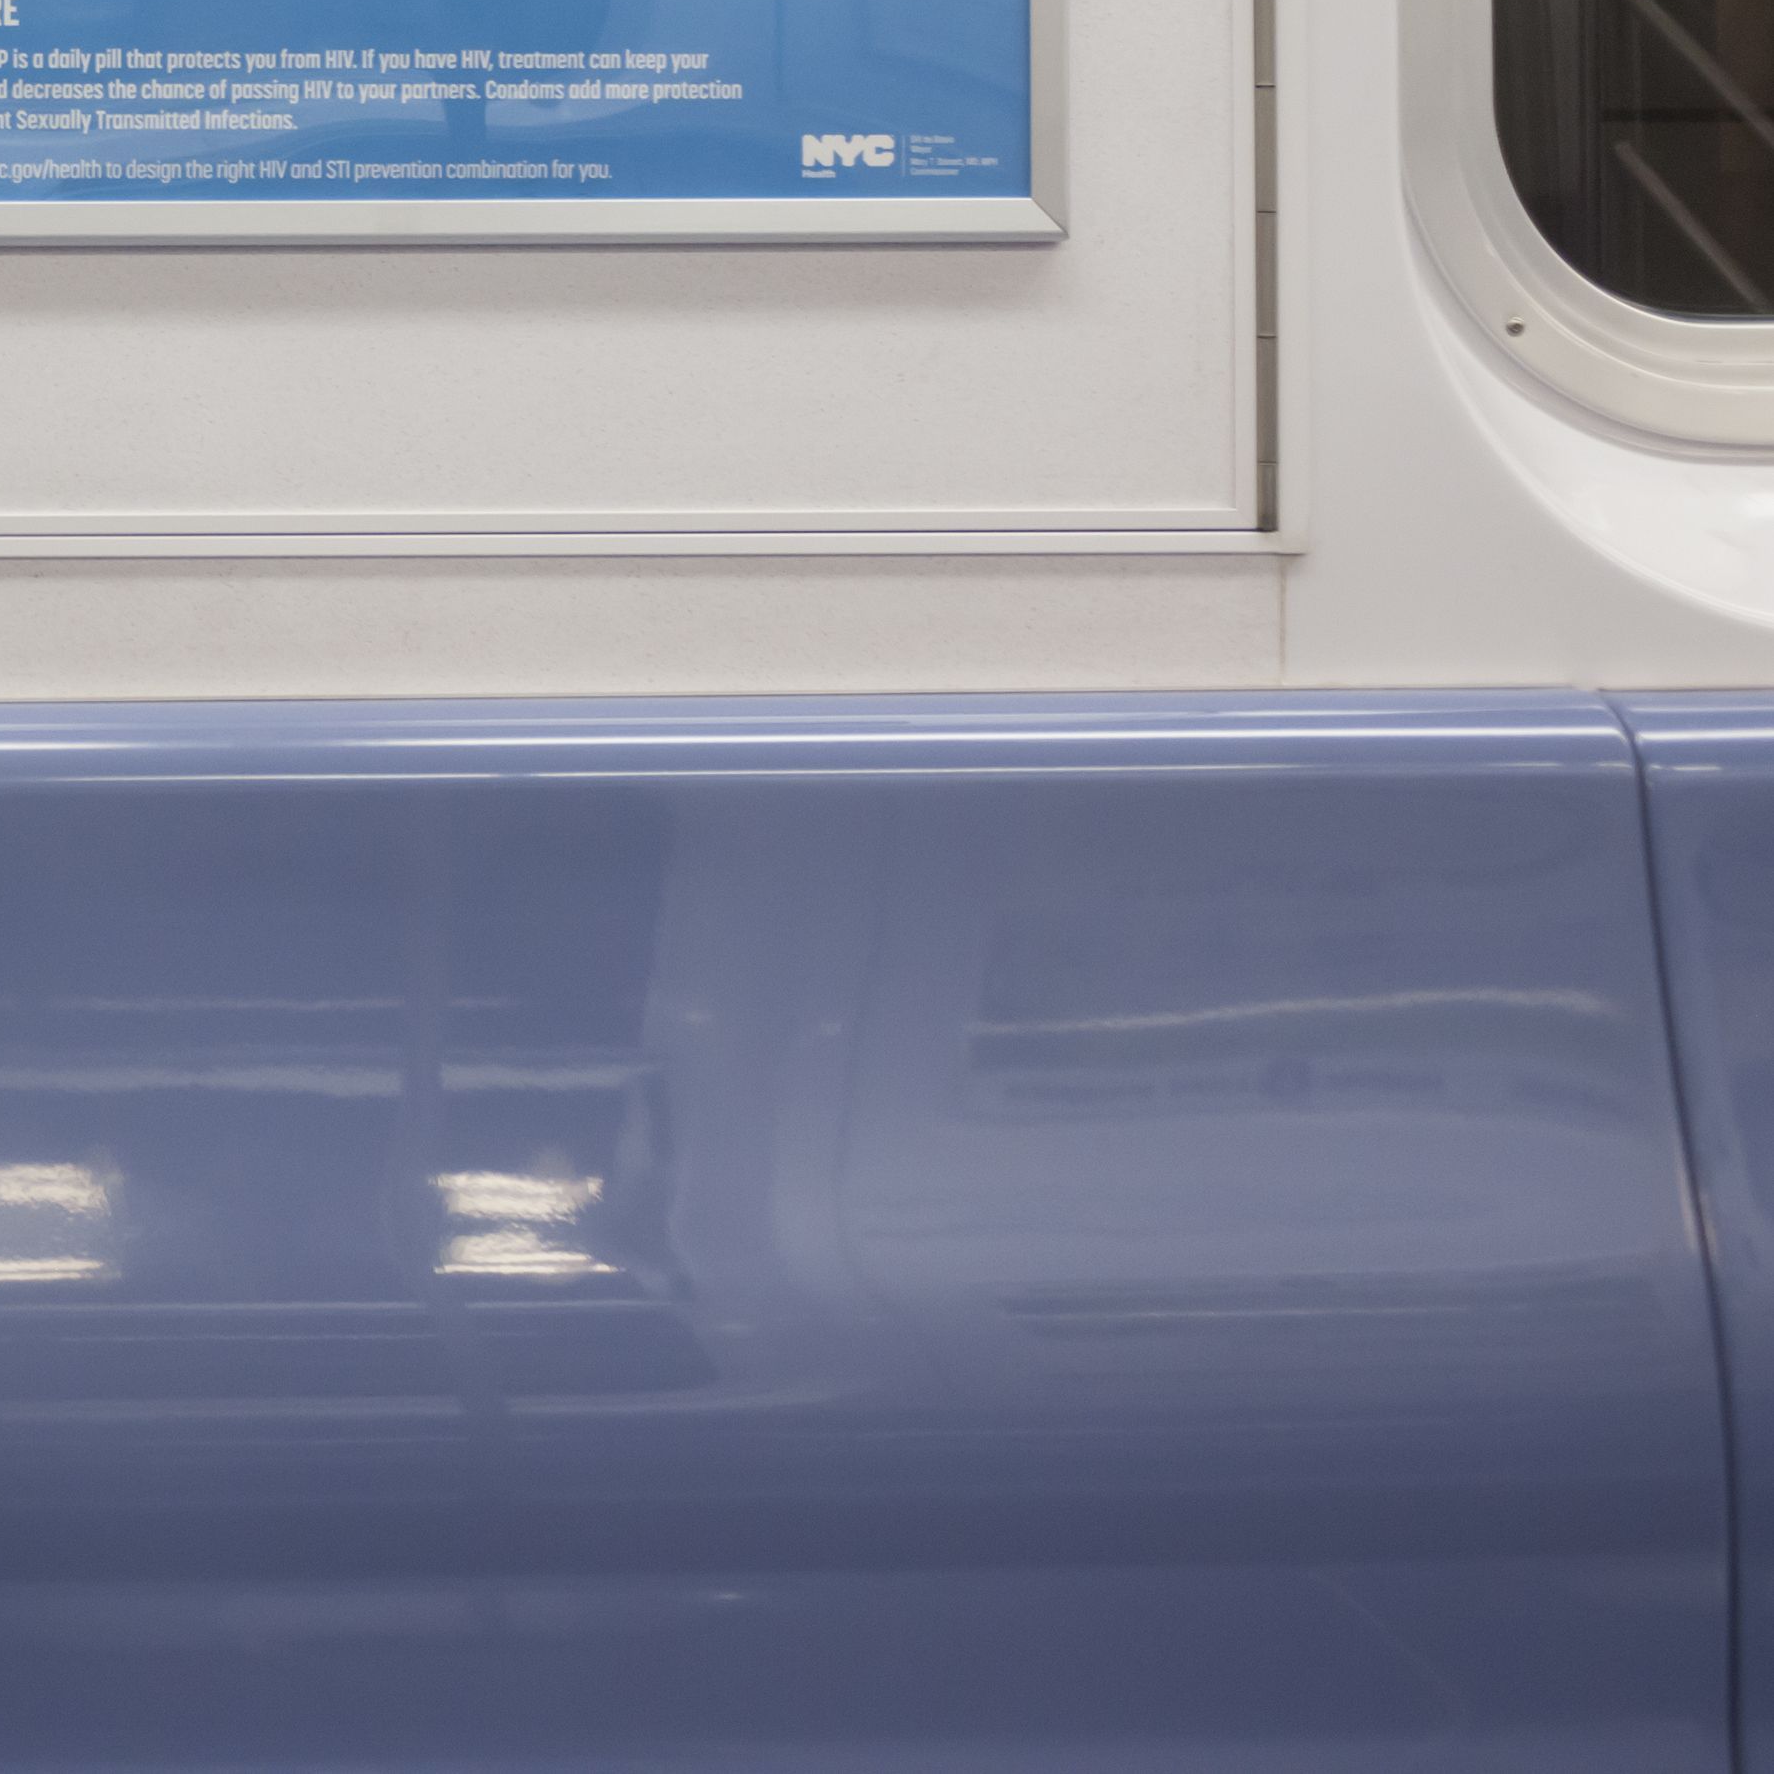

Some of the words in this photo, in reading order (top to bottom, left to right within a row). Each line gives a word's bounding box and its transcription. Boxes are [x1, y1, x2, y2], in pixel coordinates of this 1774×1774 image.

[12, 48, 29, 70] is
[33, 53, 45, 70] a
[48, 48, 91, 74] daily
[95, 48, 123, 74] pill
[126, 48, 163, 70] that
[167, 48, 242, 74] protects
[245, 53, 277, 74] you
[280, 48, 321, 70] from
[325, 48, 358, 70] HIV.
[361, 48, 375, 70] If
[379, 53, 411, 74] you
[414, 48, 458, 70] have
[461, 48, 495, 74] HIV,
[498, 48, 586, 70] treatment
[589, 53, 622, 70] can
[625, 48, 666, 74] keep
[670, 53, 710, 74] your
[11, 79, 104, 100] decreases
[108, 79, 137, 100] the
[140, 79, 206, 100] chance
[209, 79, 228, 100] of
[231, 79, 300, 105] passing
[304, 79, 333, 100] HIV
[336, 79, 355, 100] to
[358, 84, 397, 105] your
[401, 79, 482, 105] partners.
[484, 79, 566, 100] Condoms
[568, 79, 602, 100] add
[605, 84, 650, 100] more
[653, 79, 743, 105] protection
[15, 109, 92, 135] Sexually
[95, 109, 201, 130] Transmitted
[204, 109, 299, 130] Infections.
[802, 133, 897, 168] NYC
[105, 159, 124, 180] to
[125, 159, 183, 185] design
[185, 159, 214, 180] the
[216, 159, 257, 185] right
[258, 159, 288, 180] HIV
[289, 159, 322, 180] and
[325, 159, 352, 180] STI
[354, 159, 442, 185] prevention
[445, 159, 548, 180] combination
[551, 159, 575, 180] for
[577, 164, 613, 185] you.
